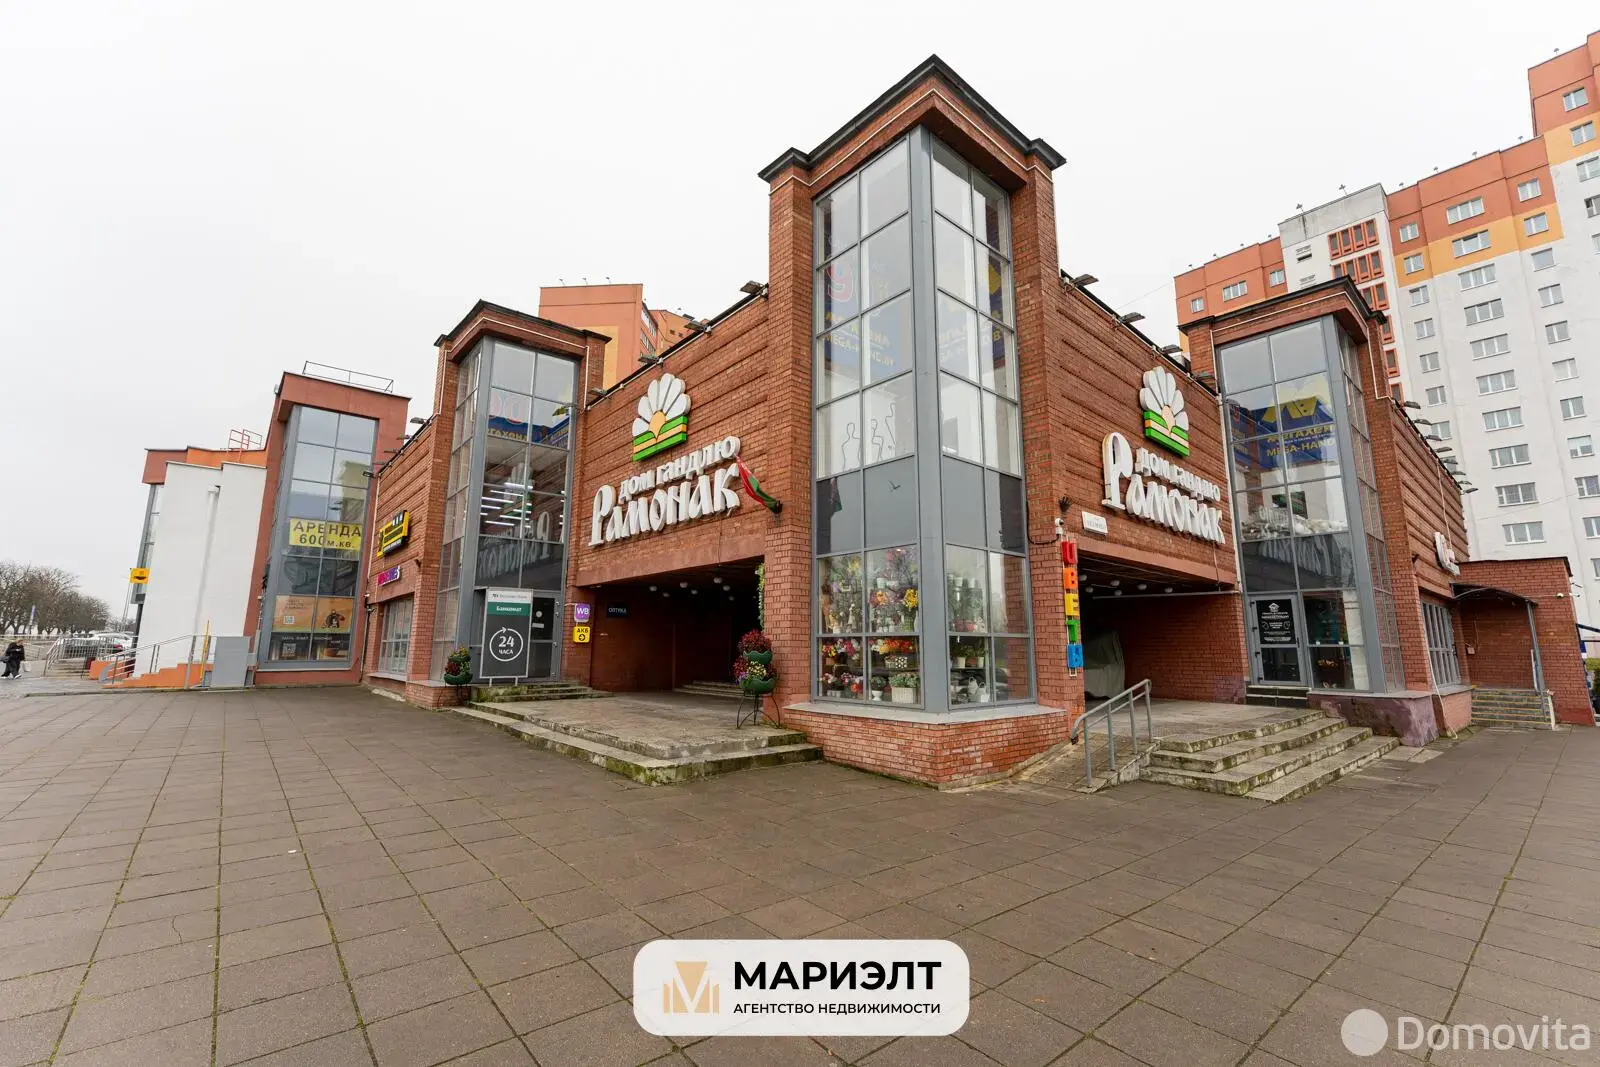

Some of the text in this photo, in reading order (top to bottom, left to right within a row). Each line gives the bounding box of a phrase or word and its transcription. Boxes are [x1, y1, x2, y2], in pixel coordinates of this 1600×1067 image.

[293, 521, 361, 537] АРЕНДА
[576, 607, 590, 615] WB
[498, 635, 515, 648] 24
